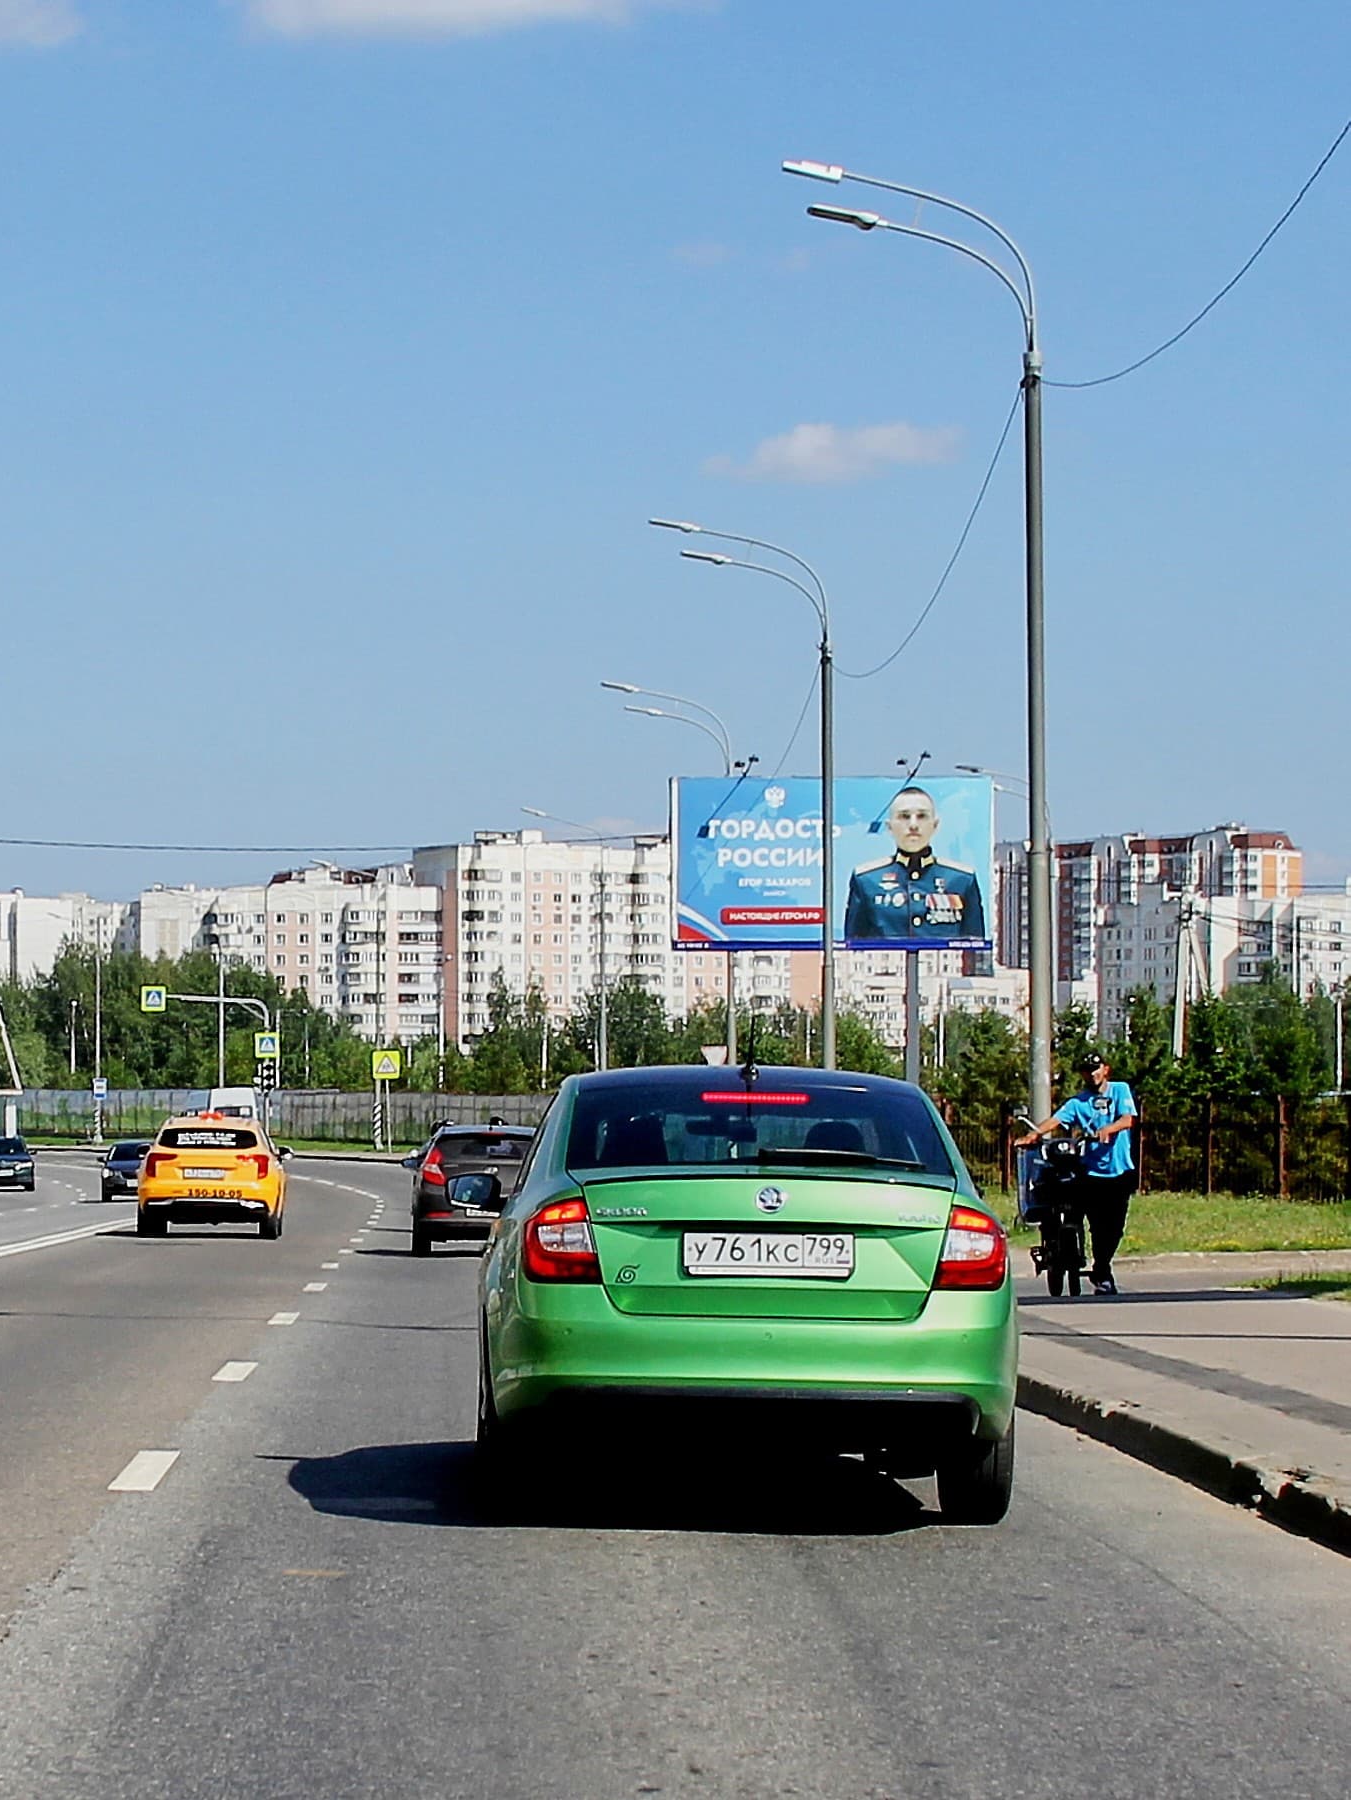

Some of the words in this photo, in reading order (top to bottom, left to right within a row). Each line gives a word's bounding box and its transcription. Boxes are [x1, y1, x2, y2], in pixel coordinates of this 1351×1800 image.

[708, 818, 842, 841] ГОРДОСТЬ
[717, 847, 824, 868] РОССИИ
[693, 1236, 800, 1263] У761КС
[805, 1236, 846, 1257] 799
